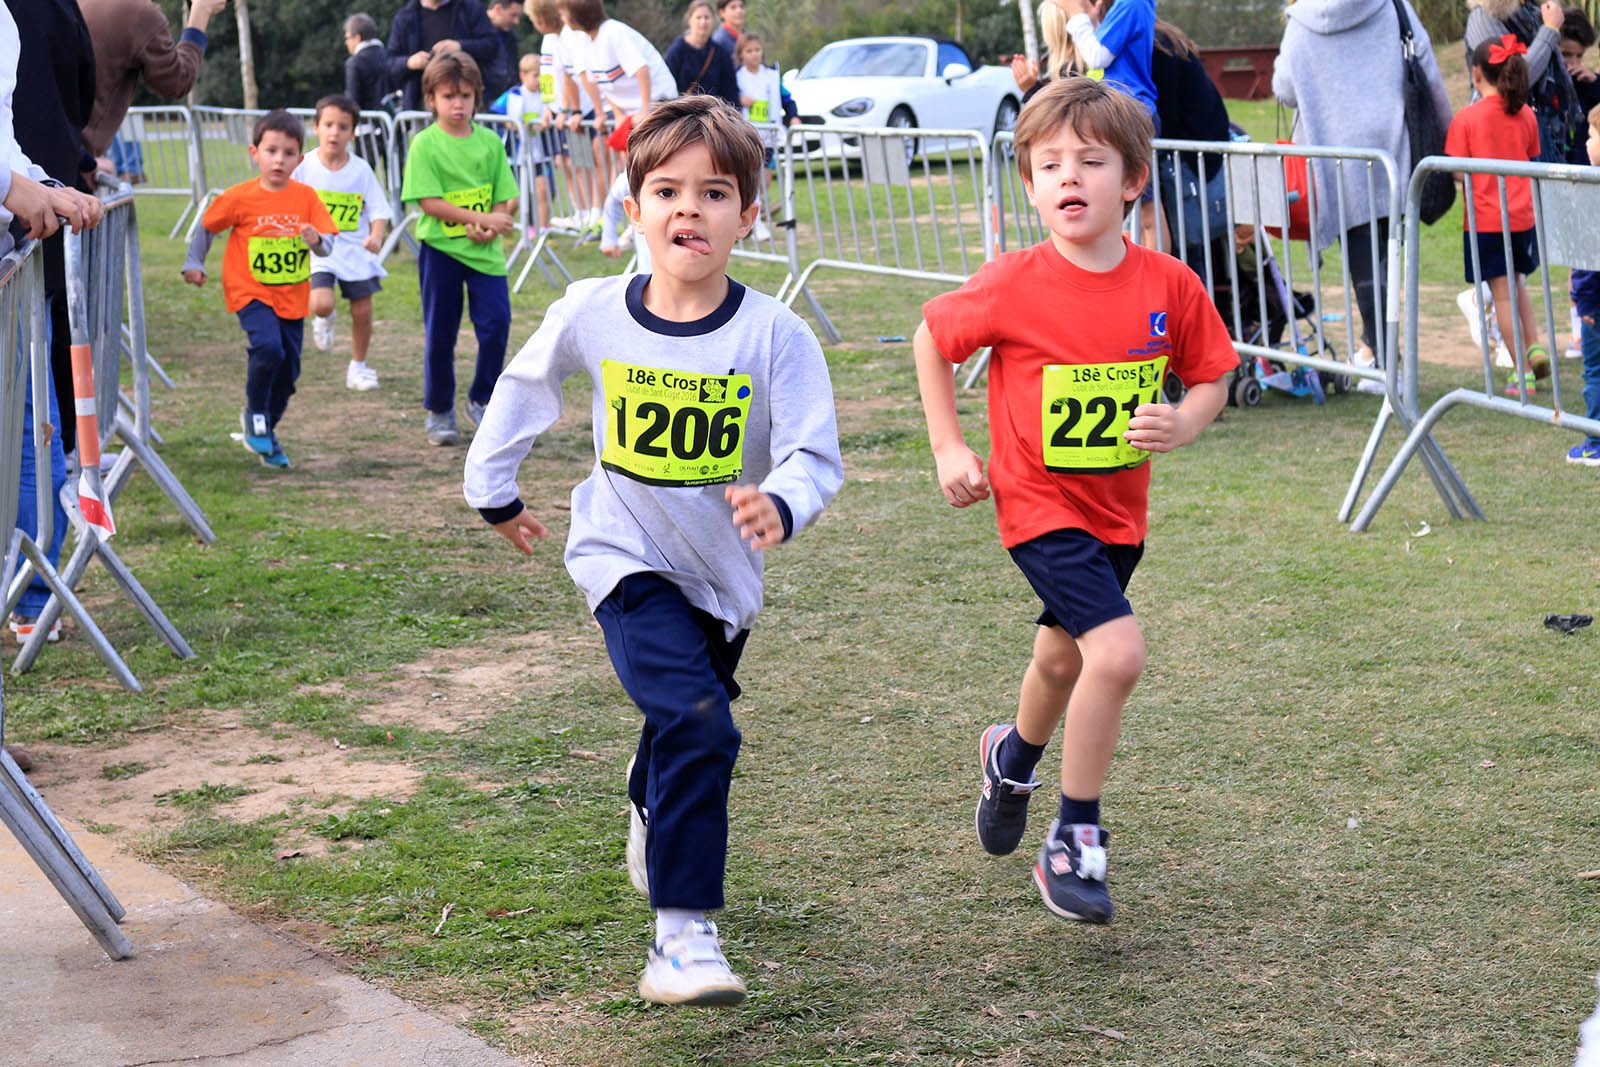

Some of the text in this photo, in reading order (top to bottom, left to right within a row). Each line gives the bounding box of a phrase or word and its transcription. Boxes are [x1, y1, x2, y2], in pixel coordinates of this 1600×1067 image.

[253, 248, 309, 274] 4397
[626, 368, 698, 391] 18è Cros
[1072, 366, 1137, 383] 18è Cros
[611, 396, 741, 460] 1206
